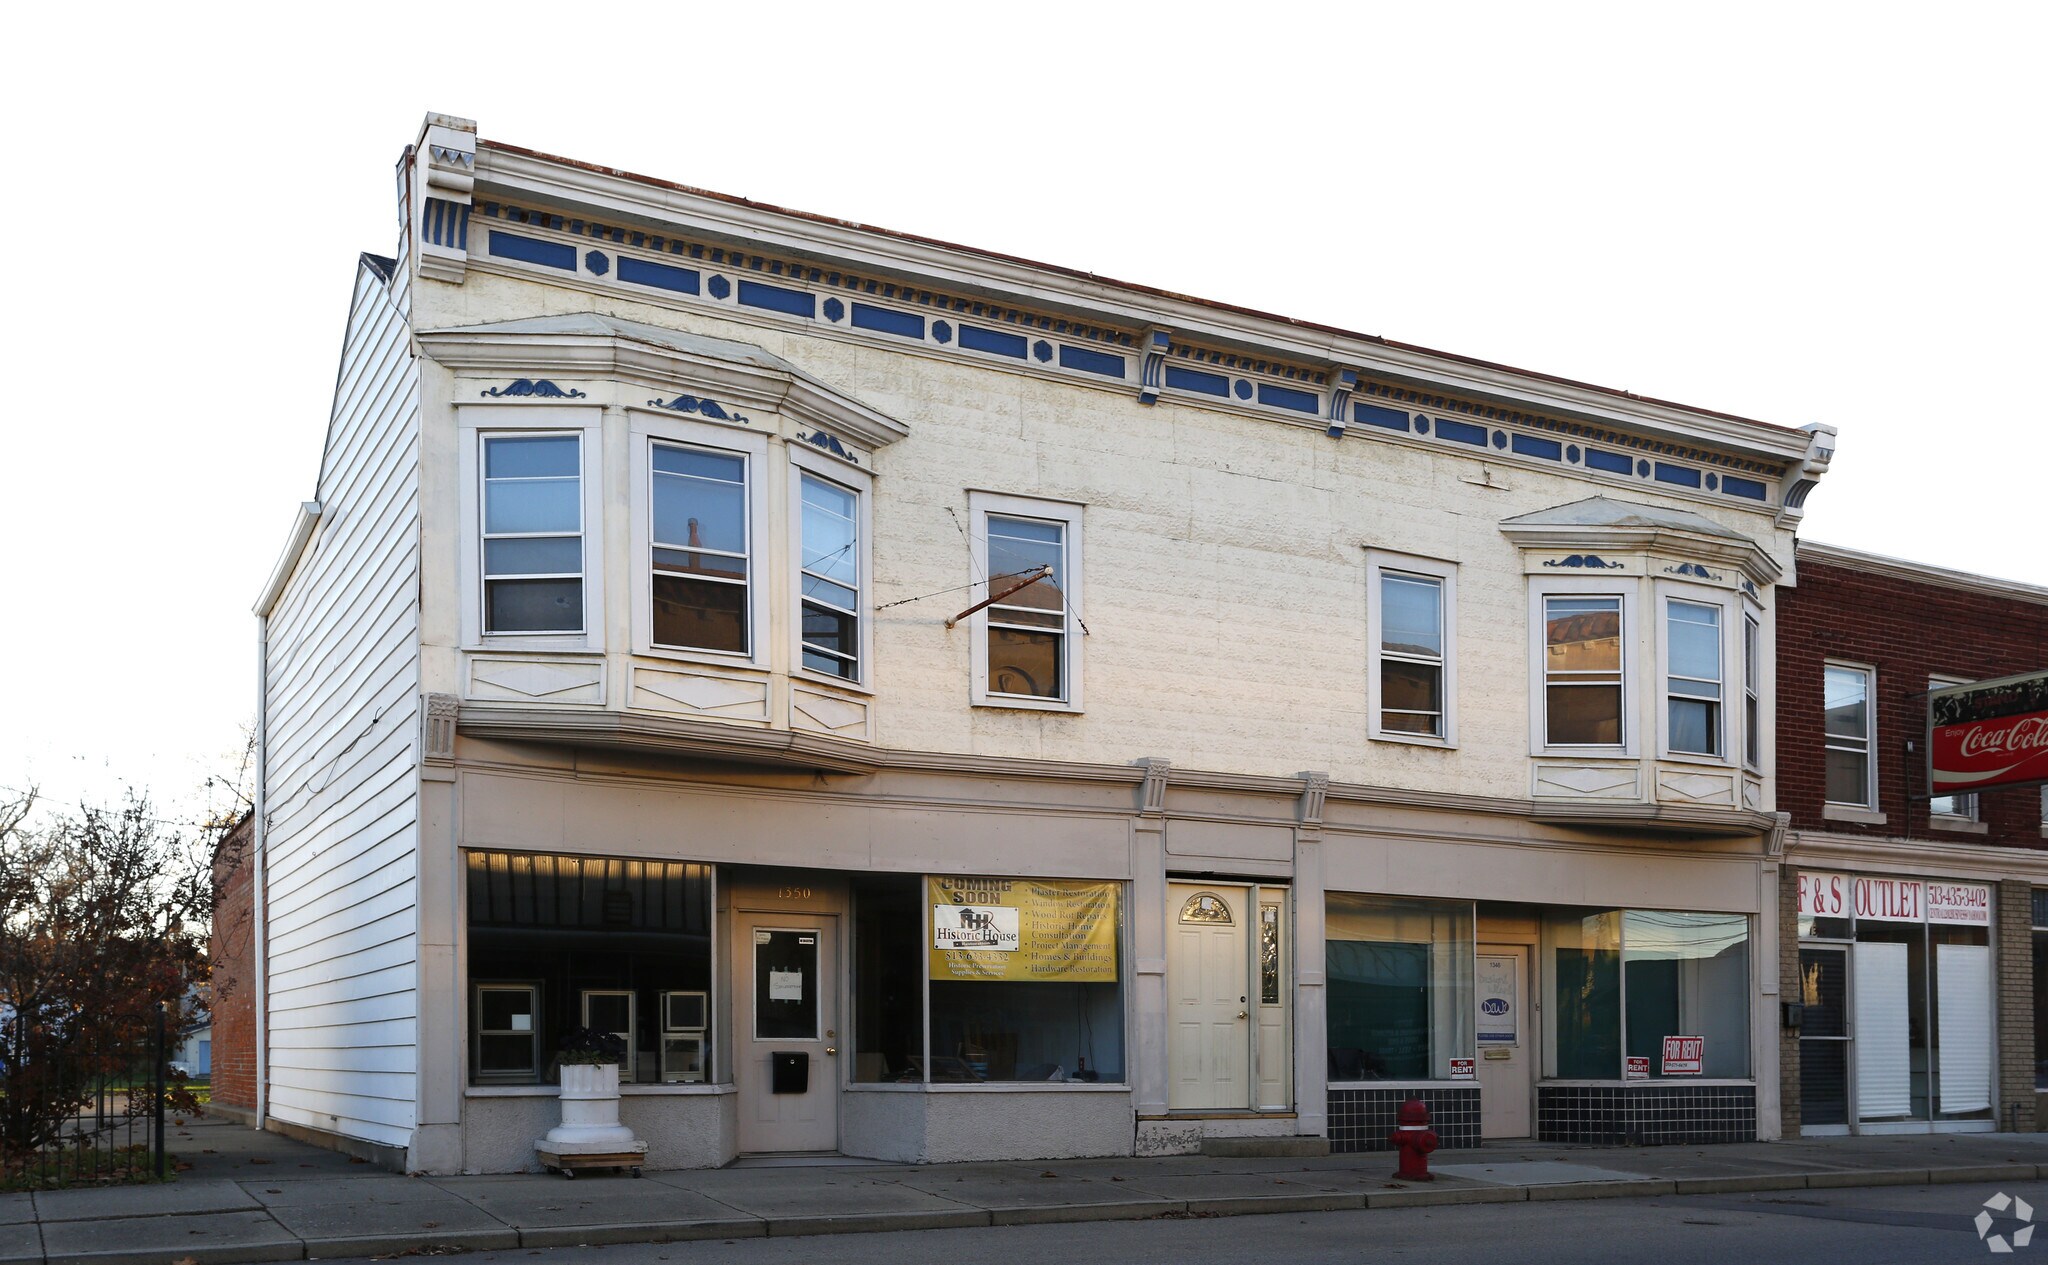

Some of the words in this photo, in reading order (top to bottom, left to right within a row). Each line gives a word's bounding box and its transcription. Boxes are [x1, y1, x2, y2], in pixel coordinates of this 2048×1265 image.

[1945, 729, 1965, 737] Enjoy
[941, 878, 1012, 892] COMING
[952, 891, 1001, 905] SOON
[1063, 888, 1110, 898] Restoration
[1798, 876, 1808, 912] F
[1814, 878, 1826, 913] &
[1831, 876, 1842, 914] S
[1855, 878, 1922, 918] OUTLET
[1066, 900, 1111, 909] Restoration
[1032, 911, 1057, 919] Wood
[1060, 911, 1074, 919] Rot
[1076, 911, 1107, 922] Repairs
[1032, 923, 1065, 931] Historic
[1068, 923, 1094, 931] Home
[937, 927, 980, 941] Historic
[983, 929, 1017, 942] House
[1031, 931, 1087, 940] Consultation
[1031, 941, 1059, 951] Project
[1062, 941, 1111, 952] Management
[1031, 952, 1061, 961] Homes
[1063, 953, 1071, 961] &
[1073, 953, 1112, 964] Buildings
[1031, 964, 1070, 973] Hardware
[1070, 964, 1112, 974] Restoration
[1665, 1040, 1681, 1060] FOR
[1681, 1040, 1701, 1060] RENT
